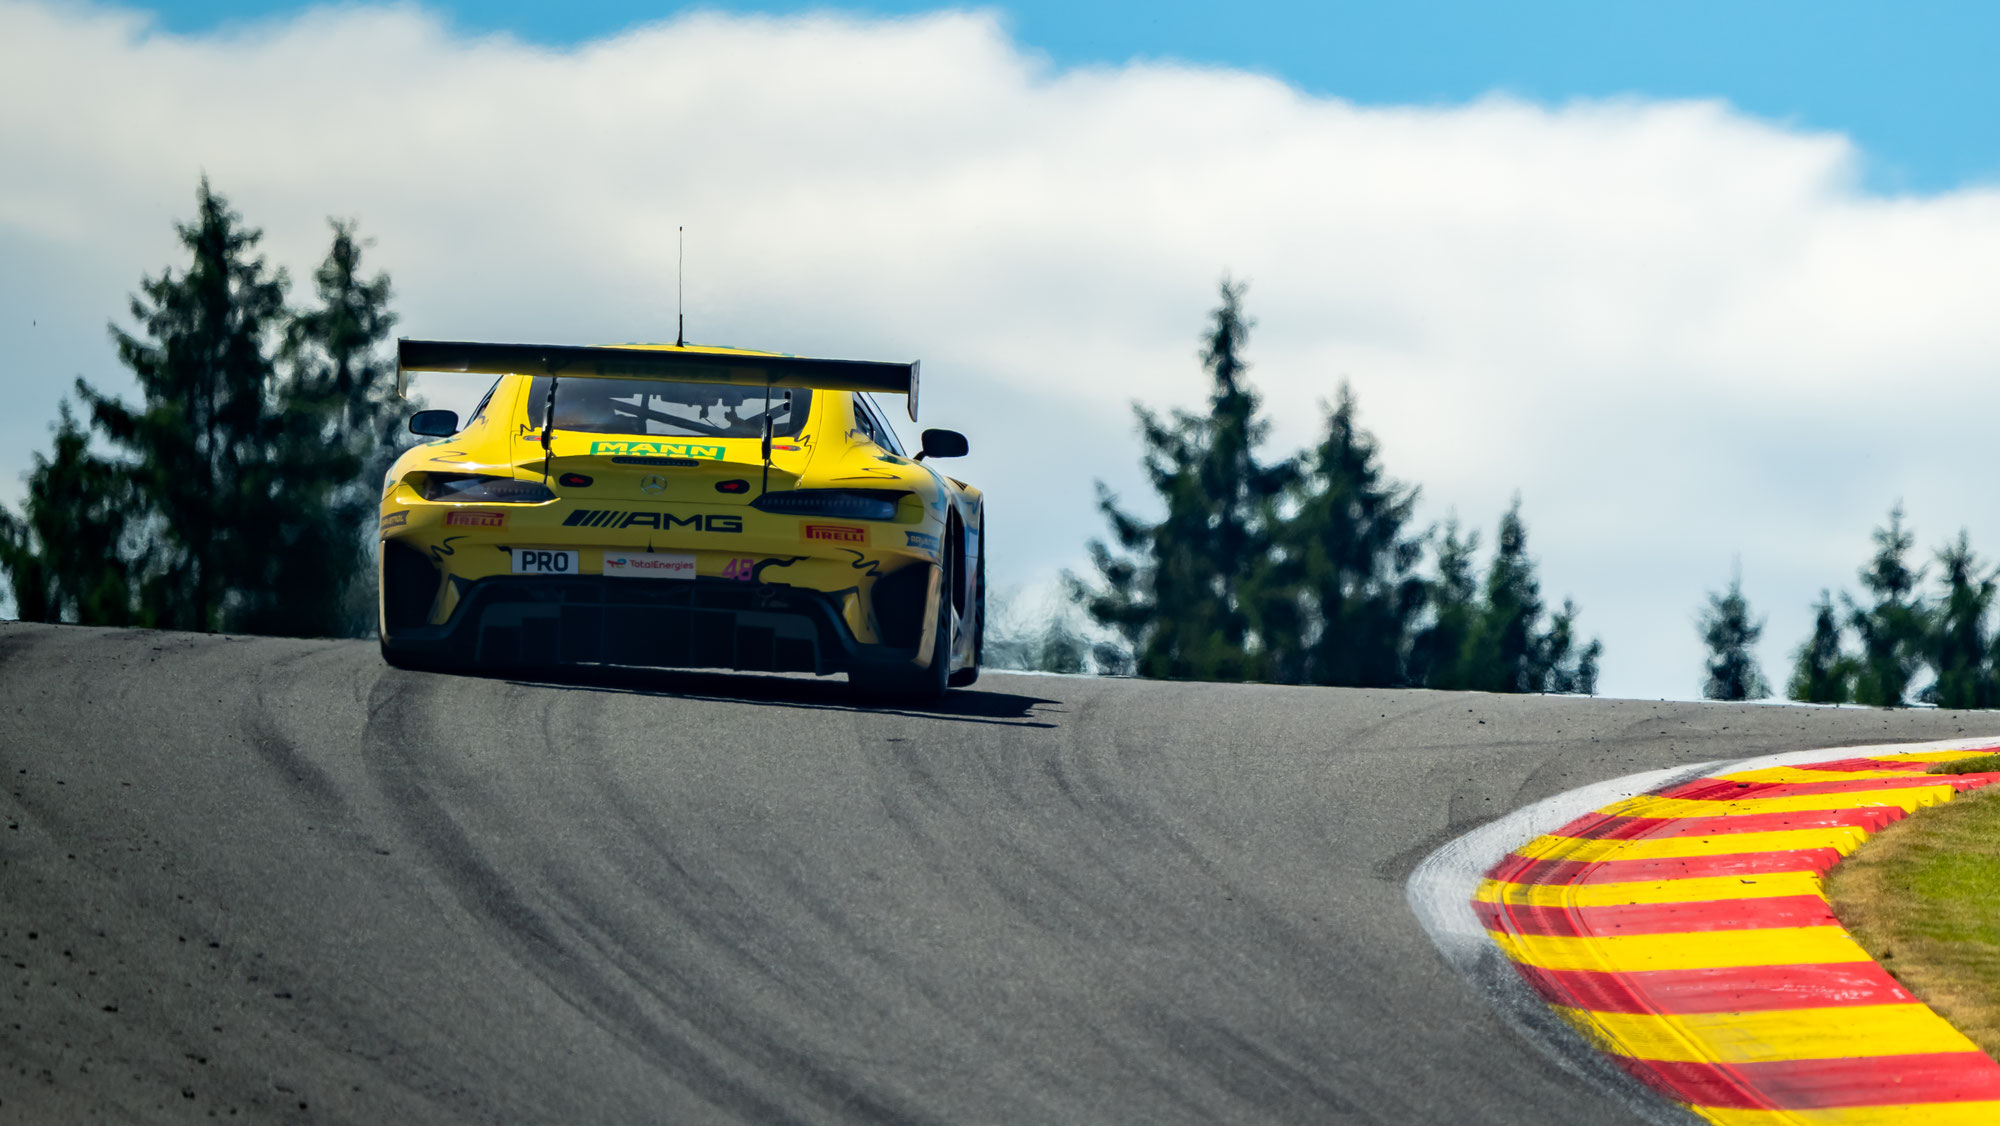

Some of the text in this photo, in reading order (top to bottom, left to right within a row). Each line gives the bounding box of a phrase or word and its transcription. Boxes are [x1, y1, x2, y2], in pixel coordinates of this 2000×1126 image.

[597, 442, 718, 456] MANN
[446, 511, 505, 527] PIRELLI
[618, 511, 743, 533] AMG
[806, 525, 865, 542] PIRELLI
[521, 551, 569, 572] PRO
[629, 559, 695, 571] TotalEnergies
[721, 558, 754, 581] 48
